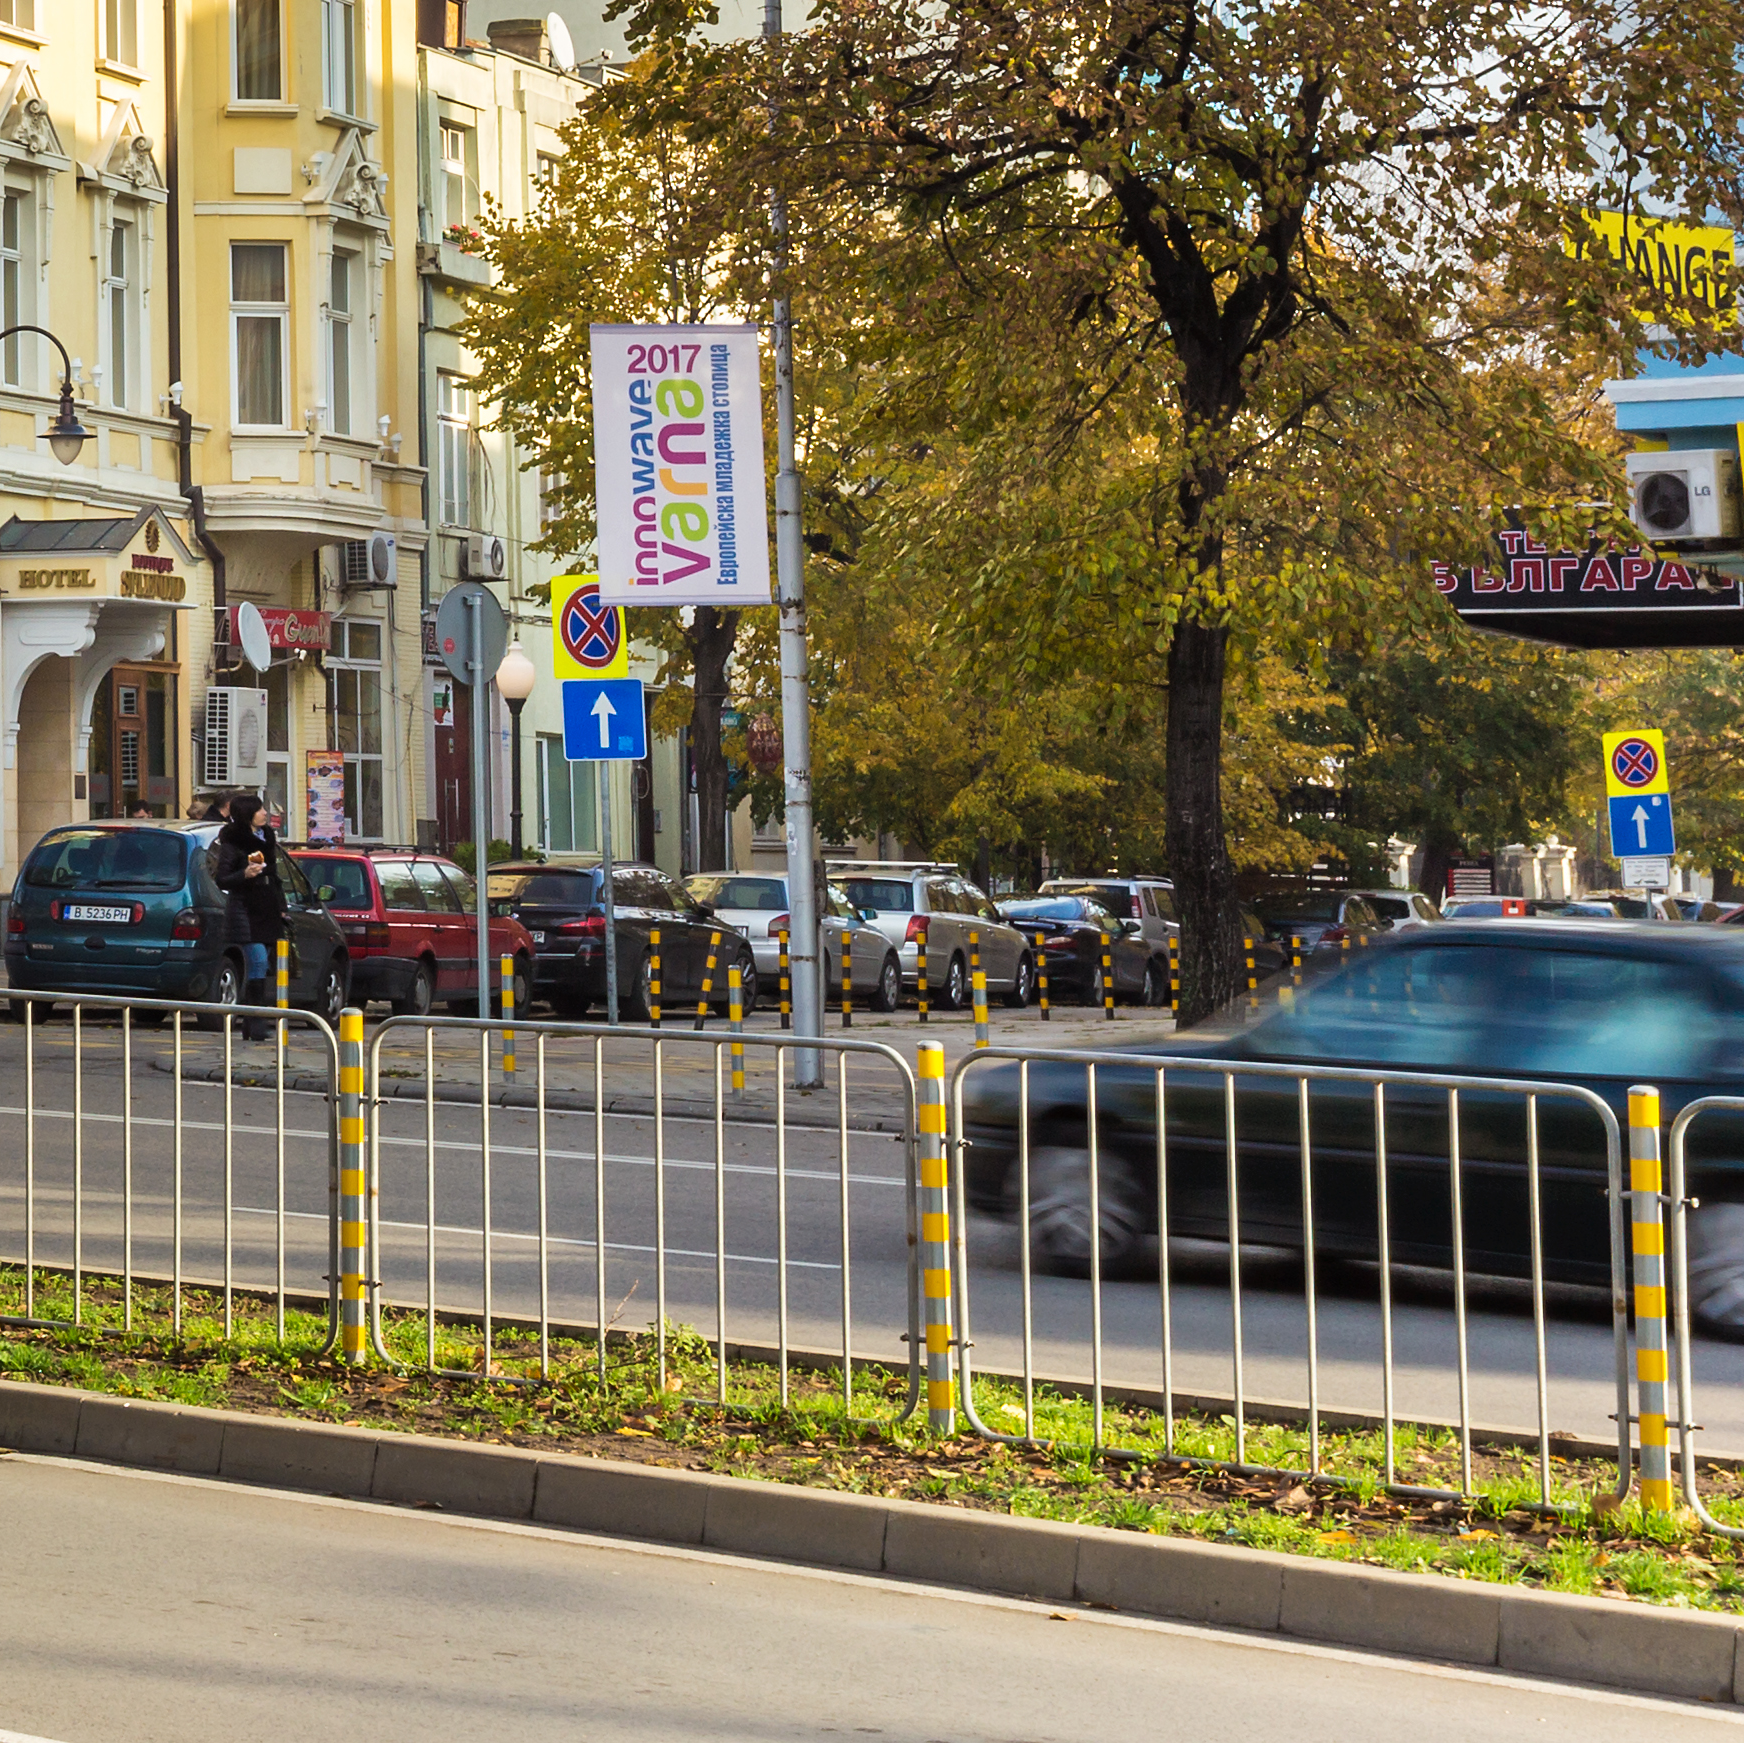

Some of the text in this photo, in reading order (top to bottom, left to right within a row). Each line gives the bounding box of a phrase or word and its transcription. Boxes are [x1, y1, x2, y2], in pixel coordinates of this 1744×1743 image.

[1575, 232, 1732, 309] HANGE
[627, 343, 702, 374] 2017
[709, 343, 739, 586] Европейска младежка столица
[628, 378, 660, 586] innowave
[1694, 485, 1711, 497] LG
[19, 568, 97, 589] HOTEL
[74, 906, 129, 921] B 5236 PH
